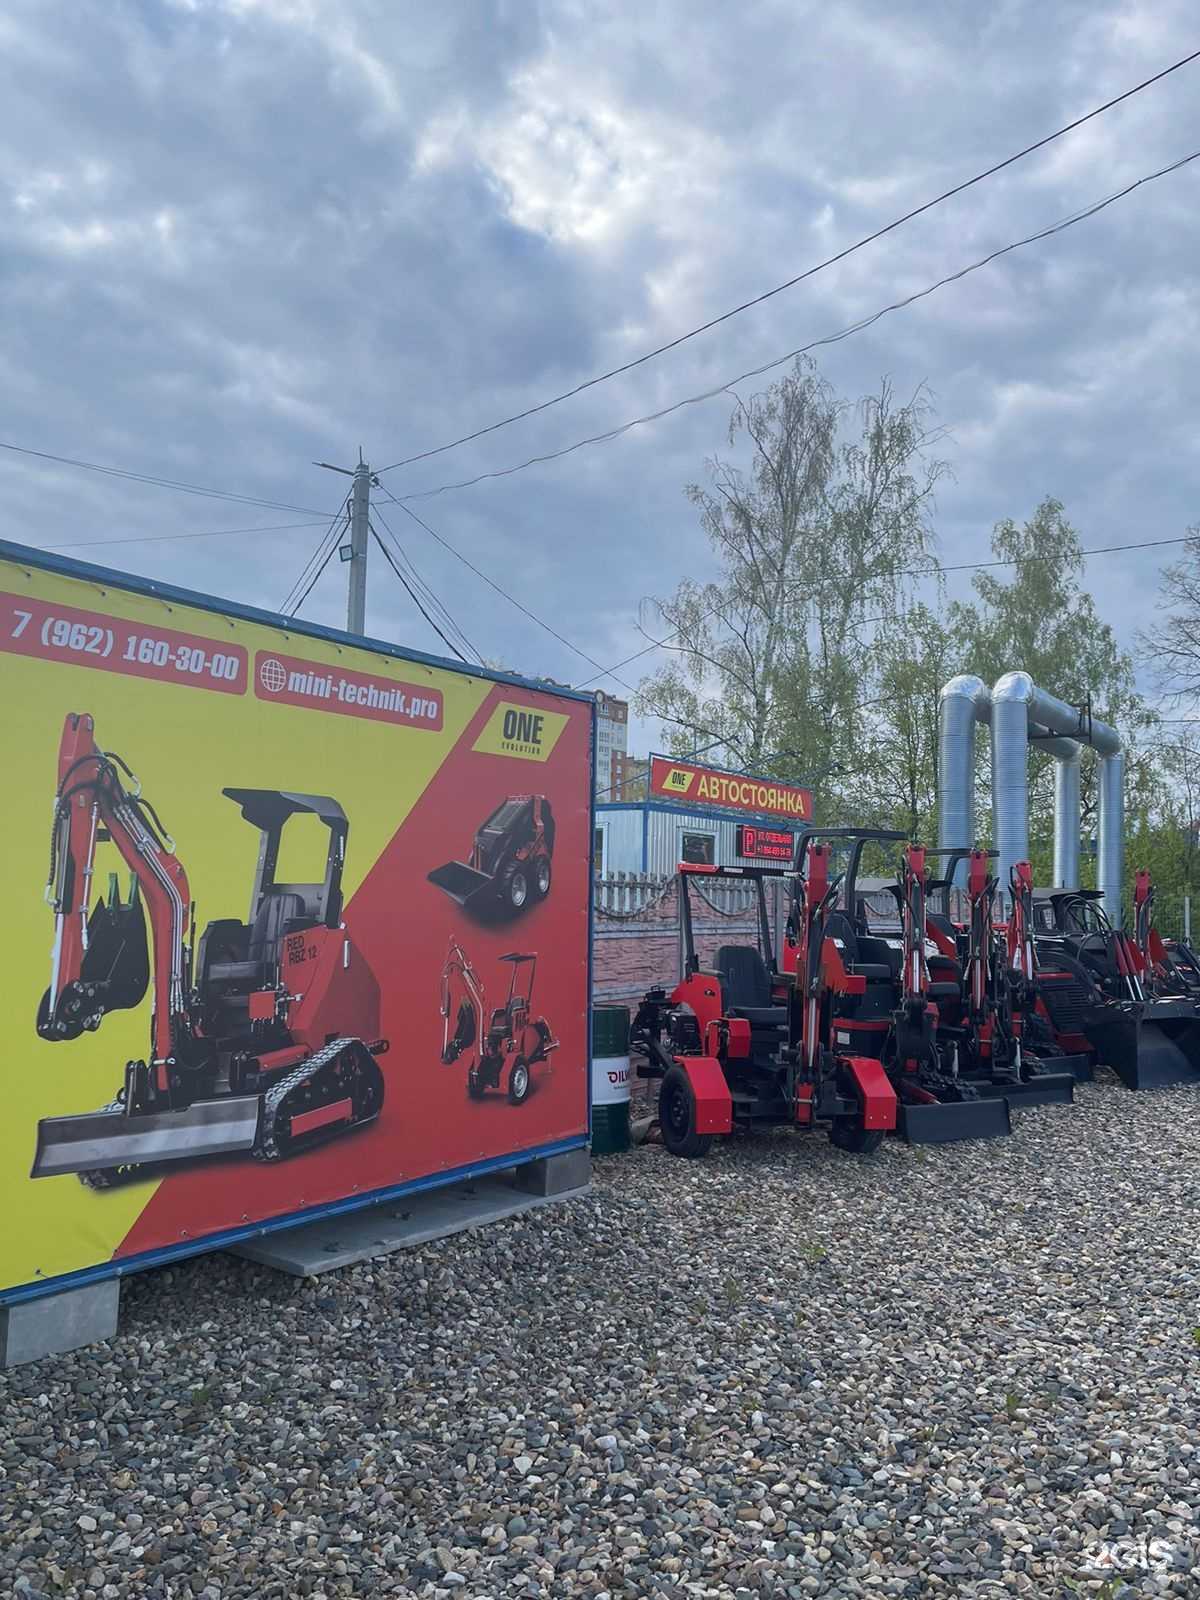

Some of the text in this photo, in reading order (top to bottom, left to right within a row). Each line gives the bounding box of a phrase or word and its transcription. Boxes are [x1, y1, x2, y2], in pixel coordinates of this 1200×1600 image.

[12, 610, 240, 680] 7 (962) 160-30-00
[288, 671, 438, 719] mini-technik.pro
[503, 710, 544, 744] ONE
[672, 771, 687, 786] ONE
[697, 775, 805, 814] АВТОСТОЯНКА
[287, 935, 305, 952] RED
